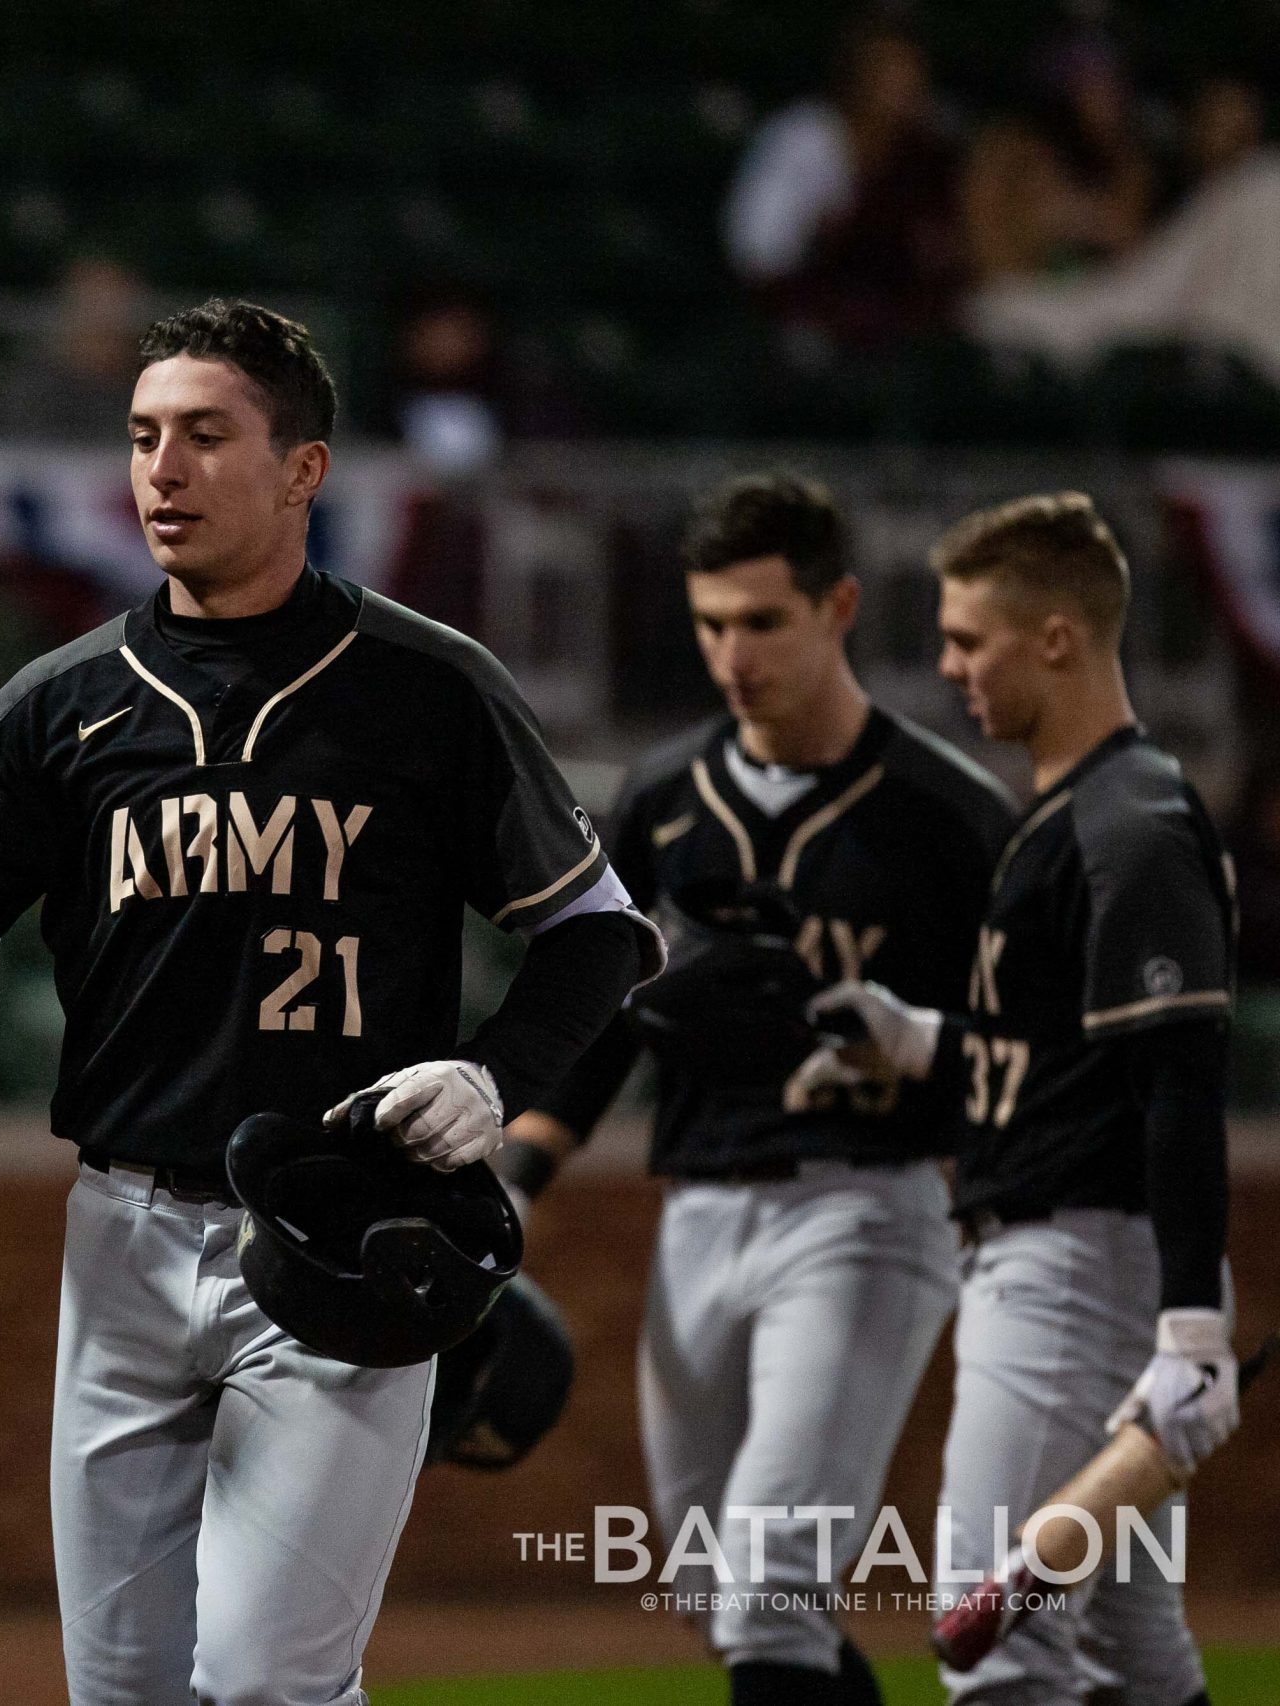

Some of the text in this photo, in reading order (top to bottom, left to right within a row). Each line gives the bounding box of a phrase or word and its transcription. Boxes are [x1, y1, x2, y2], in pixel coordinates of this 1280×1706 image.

[110, 792, 373, 912] ARMY
[259, 927, 362, 1036] 21
[962, 1032, 1030, 1127] 37
